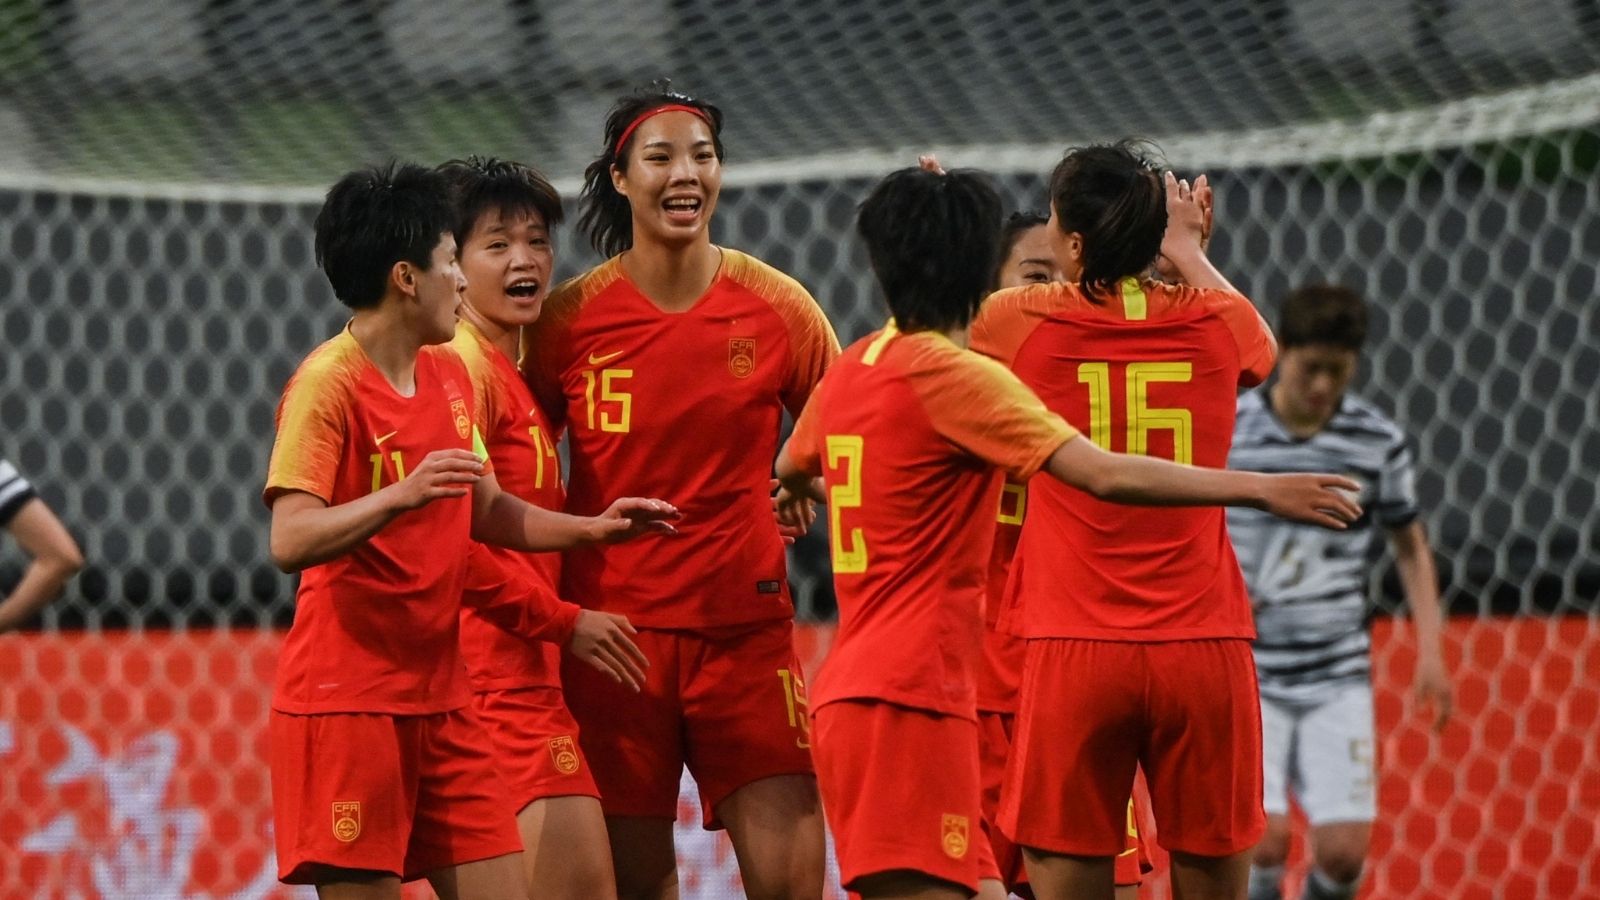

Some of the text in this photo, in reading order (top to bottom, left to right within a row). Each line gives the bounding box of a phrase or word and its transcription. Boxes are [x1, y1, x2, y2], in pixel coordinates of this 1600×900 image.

[731, 341, 753, 349] CFA
[582, 369, 633, 433] 15
[1077, 361, 1193, 465] 16
[369, 451, 406, 491] 11
[825, 434, 868, 574] 2
[551, 739, 571, 748] CFA
[335, 804, 358, 813] CFA
